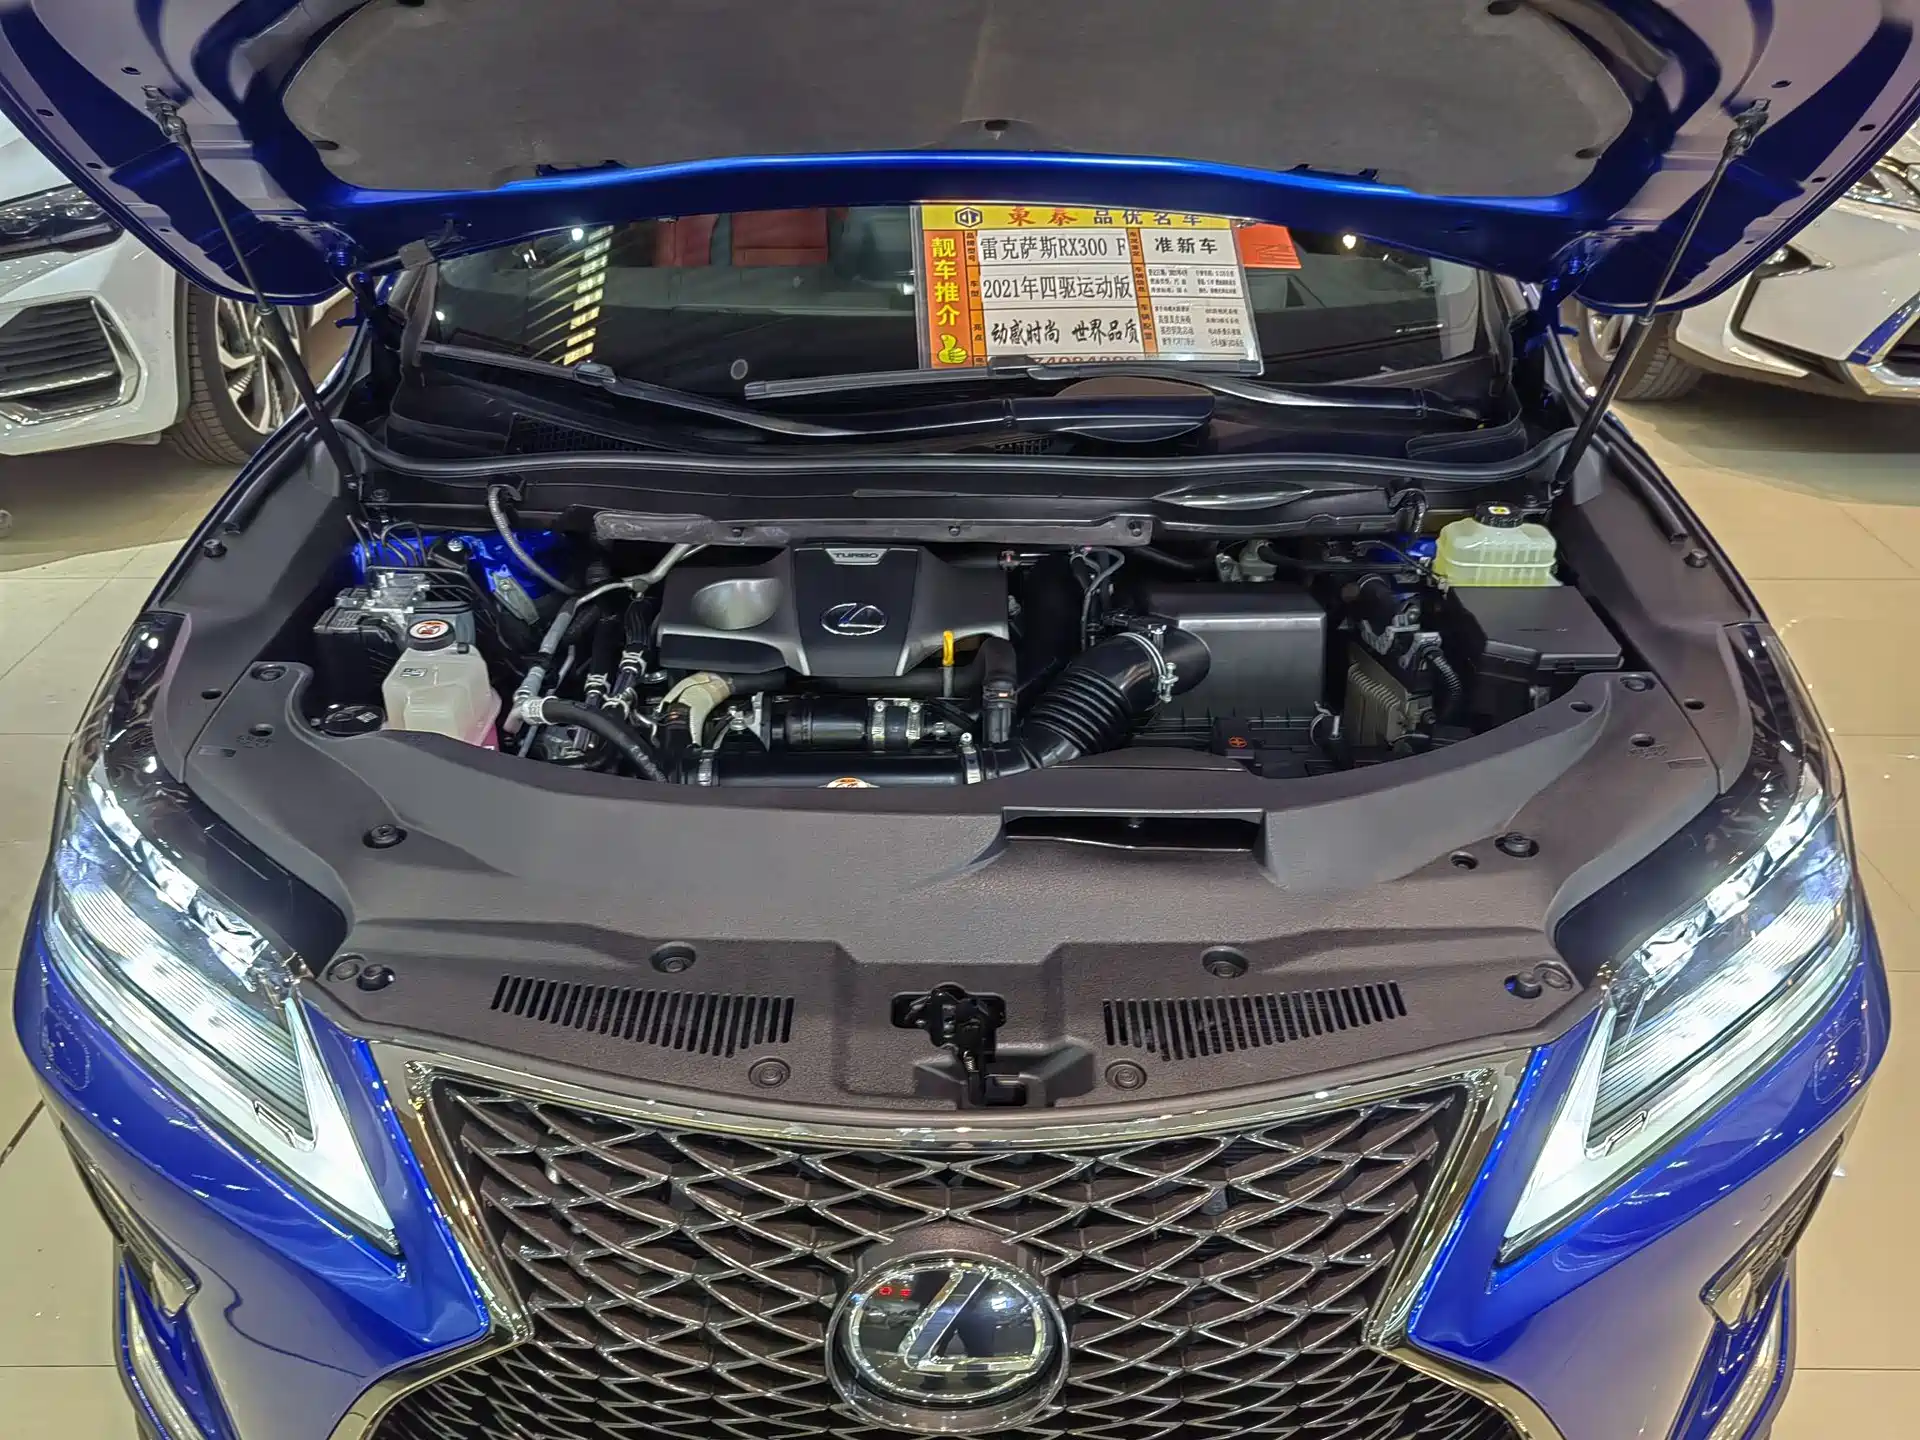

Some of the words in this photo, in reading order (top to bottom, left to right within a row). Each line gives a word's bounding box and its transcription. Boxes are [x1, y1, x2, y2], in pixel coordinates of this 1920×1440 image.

[1094, 209, 1202, 226] 品优名车
[980, 236, 1107, 260] 雷克萨斯RX300
[1154, 237, 1218, 254] 准新车
[931, 237, 960, 326] 靓车推介
[983, 275, 1133, 300] 2021年四驱运动版
[991, 319, 1060, 346] 动感时尚
[1072, 317, 1139, 346] 世界品质
